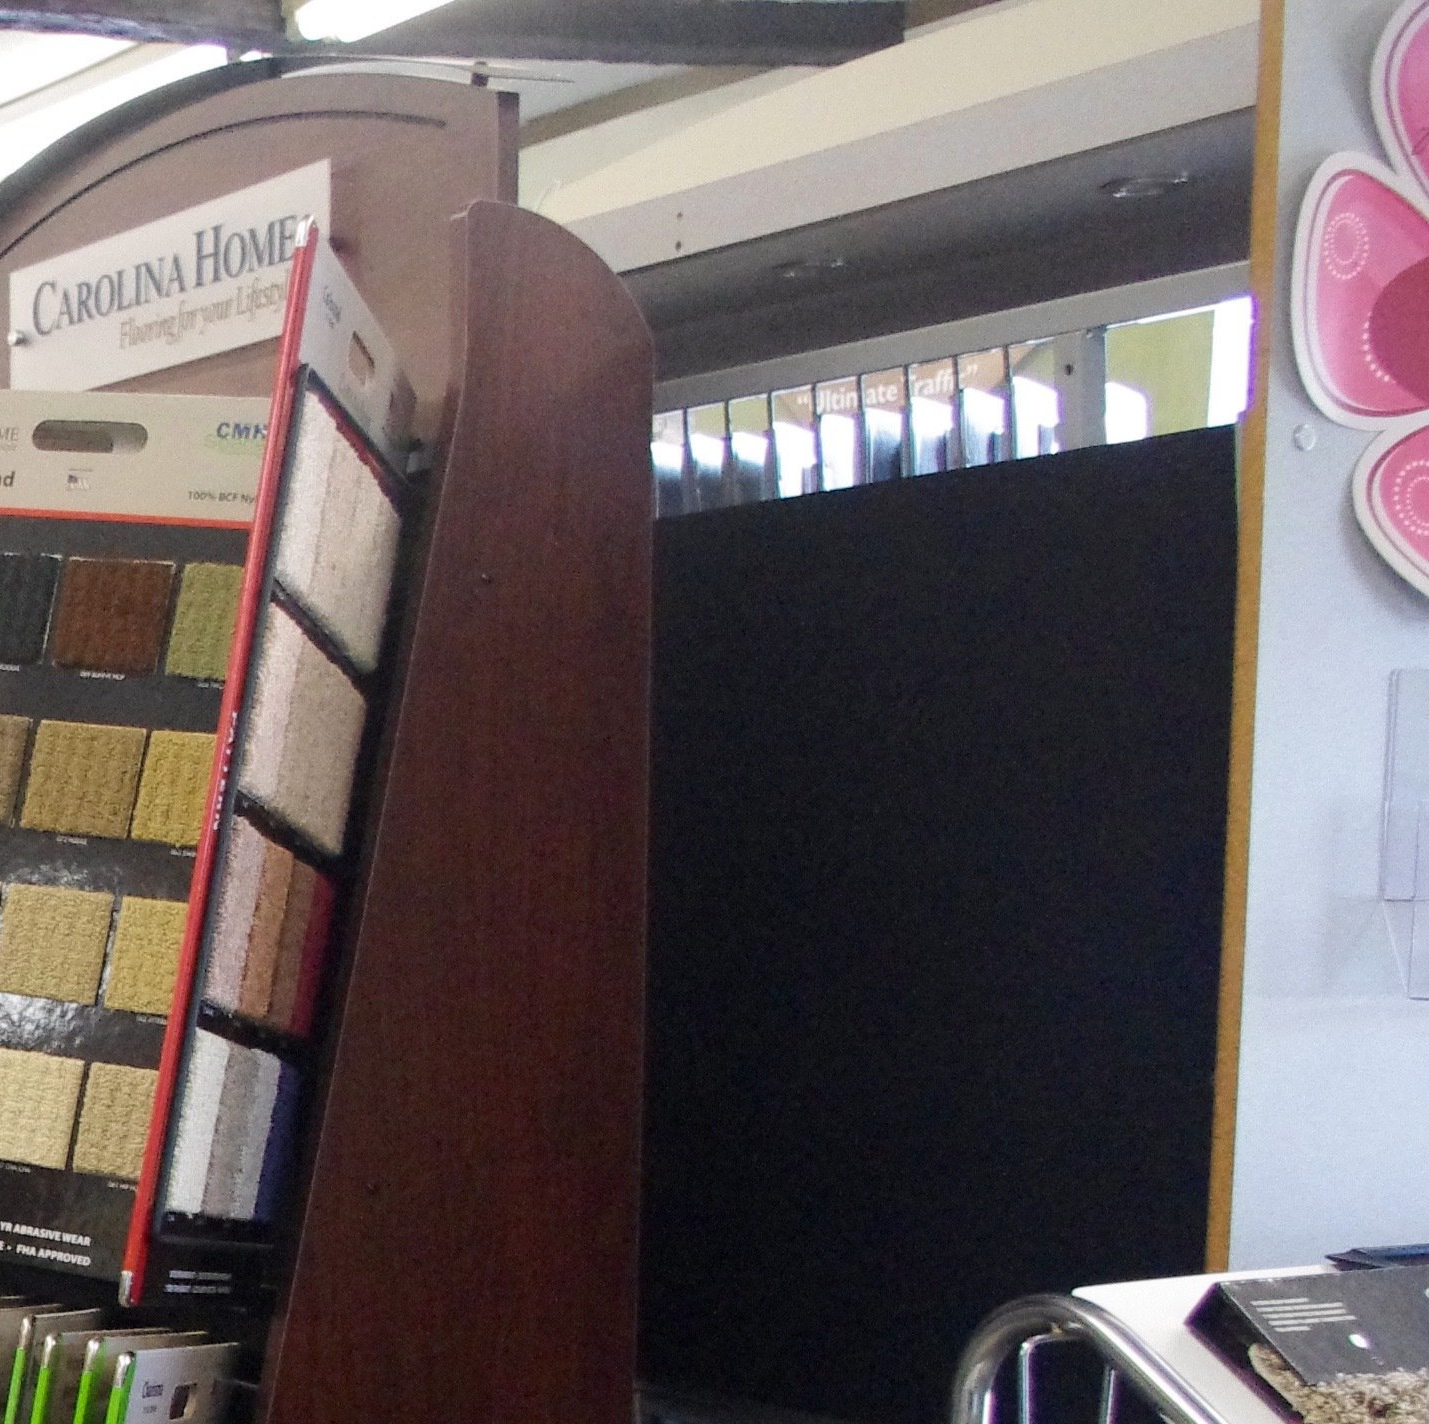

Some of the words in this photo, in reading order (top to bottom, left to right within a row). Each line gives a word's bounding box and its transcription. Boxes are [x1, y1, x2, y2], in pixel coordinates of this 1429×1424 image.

[32, 252, 186, 336] CAROLINA
[188, 490, 216, 501] 100%
[218, 492, 238, 502] BCF
[0, 1221, 13, 1233] YR
[14, 1223, 61, 1242] ABRASIVE
[61, 1232, 91, 1247] WEAR
[16, 1243, 36, 1257] FHA
[38, 1247, 91, 1267] APPROVED
